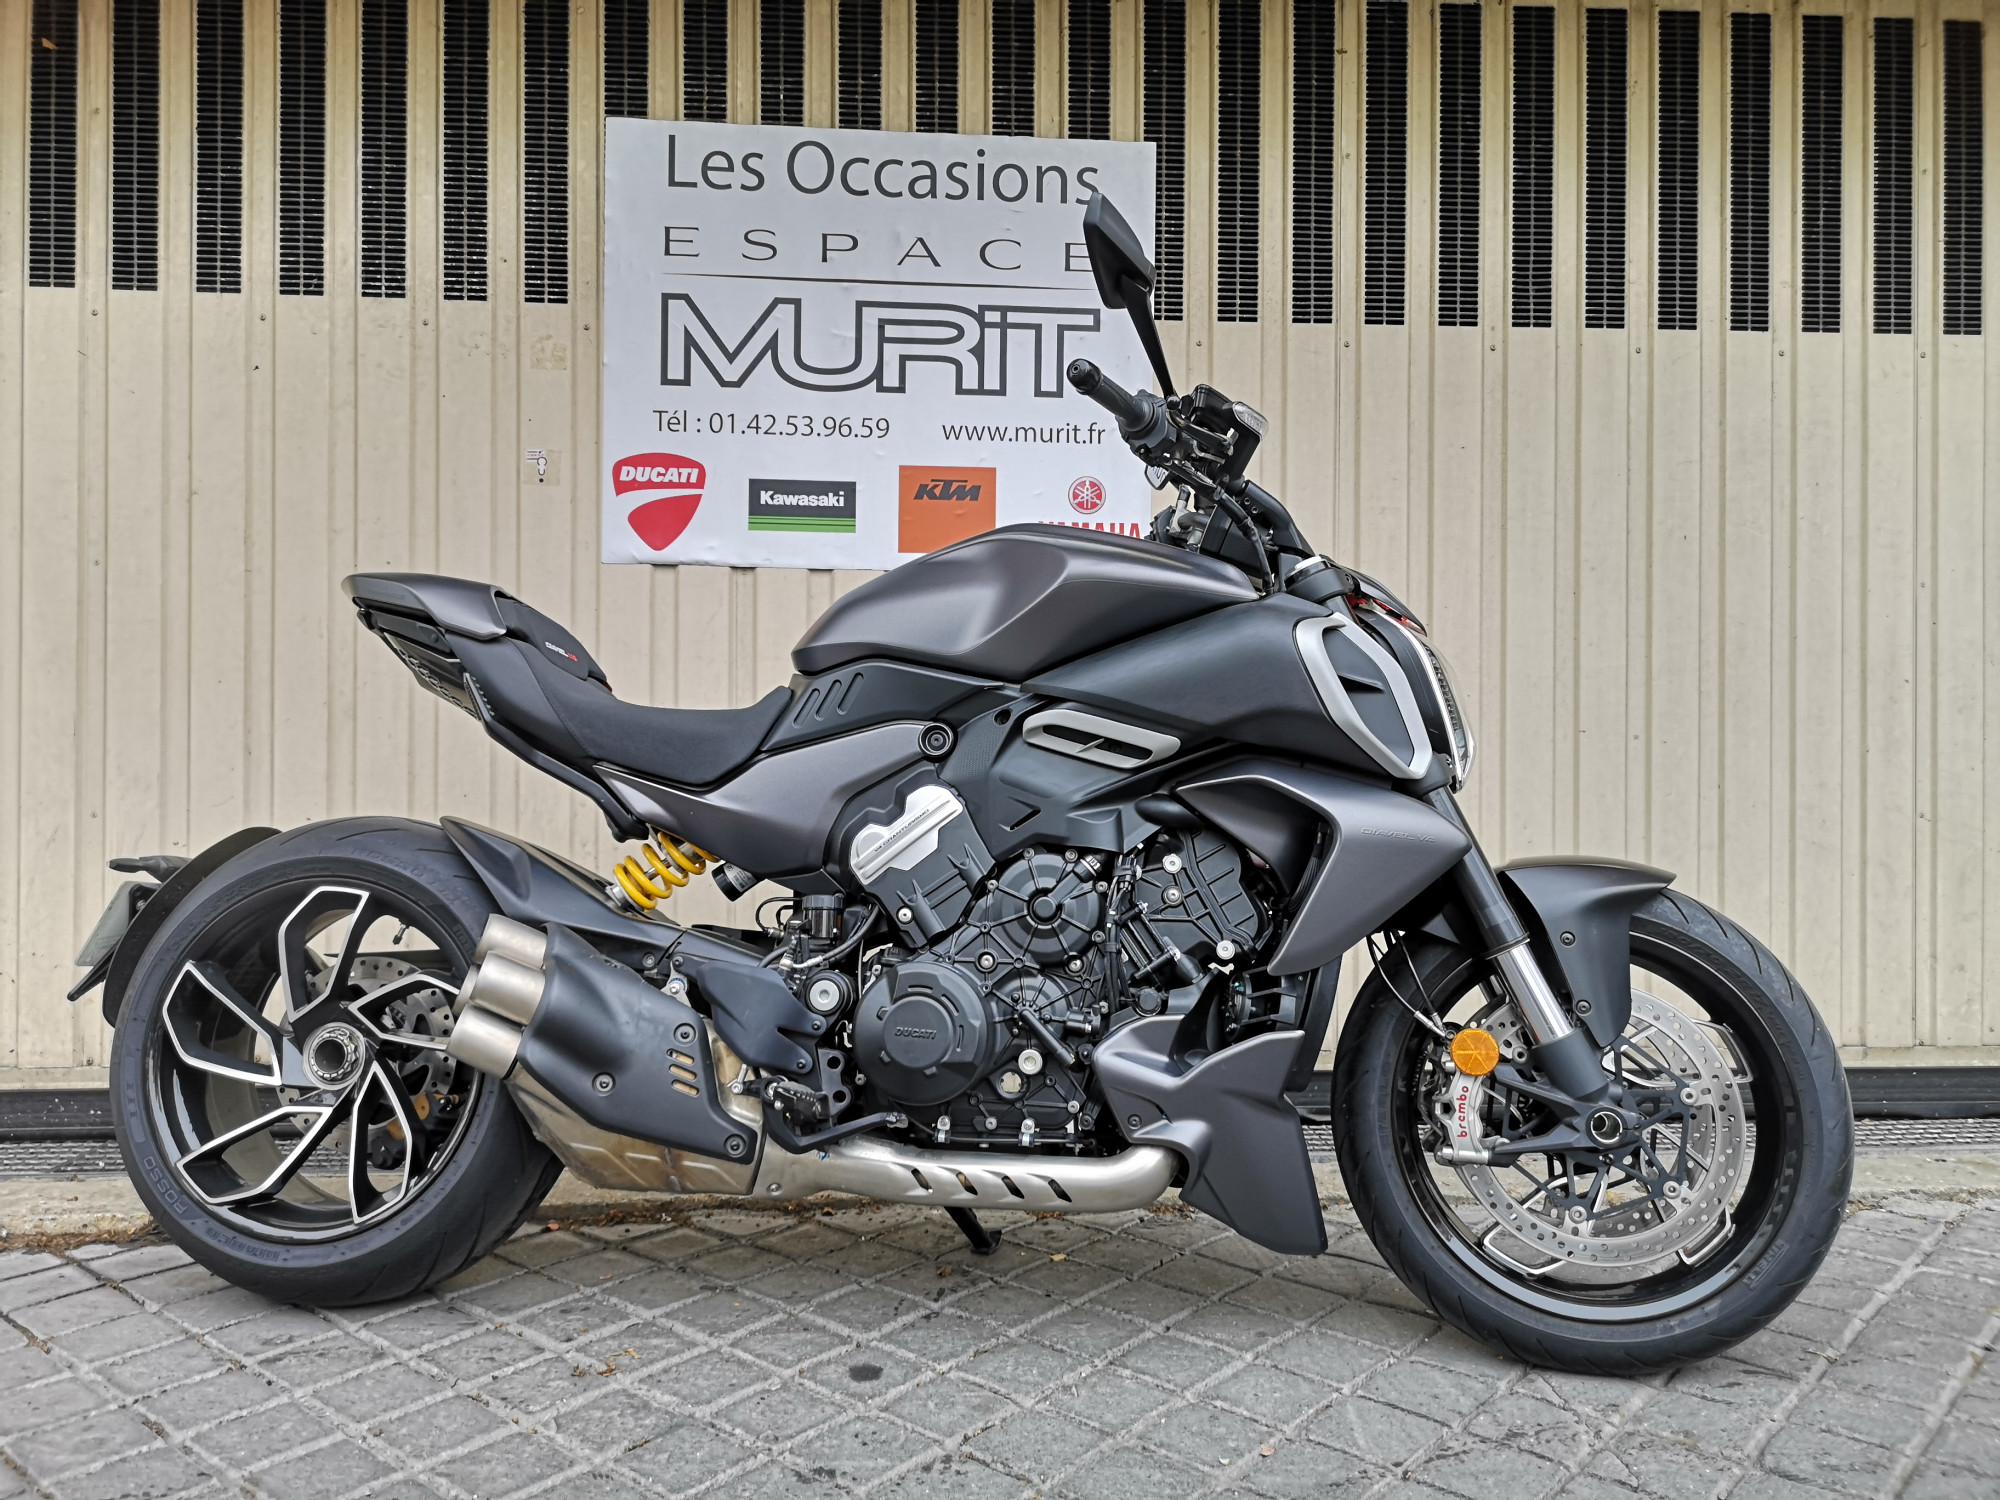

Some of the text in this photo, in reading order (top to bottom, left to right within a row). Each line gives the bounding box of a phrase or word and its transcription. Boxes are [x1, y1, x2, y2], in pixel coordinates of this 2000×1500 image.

[667, 134, 1100, 206] Les Occasions
[663, 225, 1093, 273] ESPACE
[653, 409, 687, 433] Tél
[708, 412, 891, 439] 01.42.53.96.59
[942, 421, 1106, 445] www.murit.fr
[619, 465, 699, 483] DUCATI
[759, 490, 845, 507] Kawasaki
[912, 478, 981, 502] KTM
[1360, 827, 1416, 841] DIAVEL
[895, 1026, 937, 1040] DUCATI
[1456, 1085, 1469, 1138] brembo
[144, 1155, 188, 1214] ROSSO
